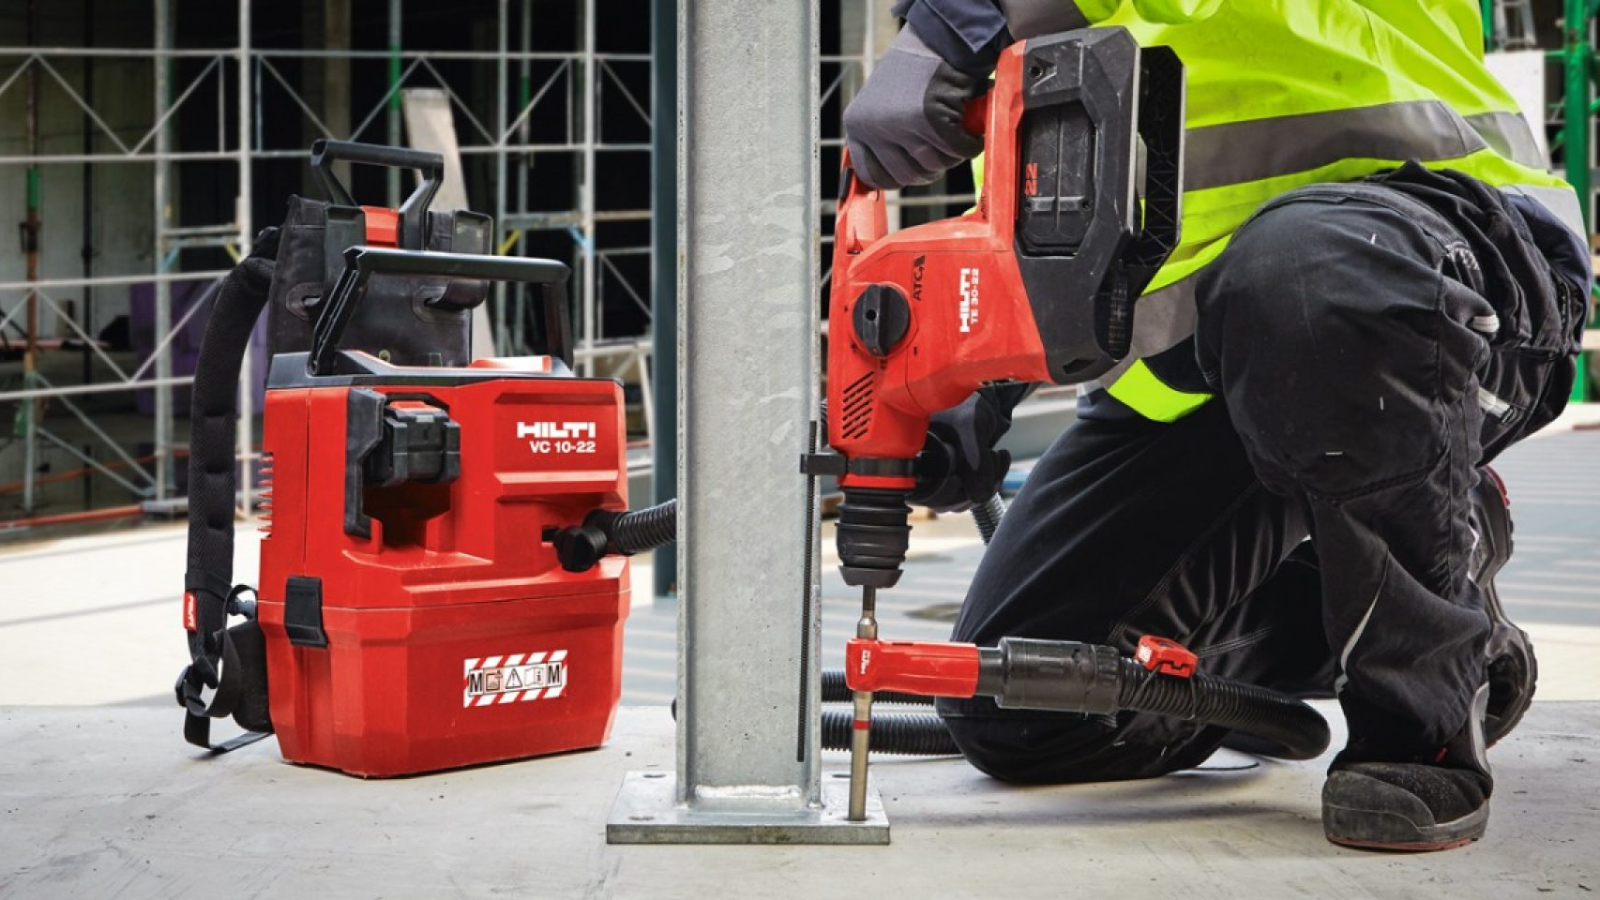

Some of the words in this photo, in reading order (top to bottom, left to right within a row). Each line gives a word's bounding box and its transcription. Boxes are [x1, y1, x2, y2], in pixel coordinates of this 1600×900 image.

[1025, 163, 1038, 195] 22
[960, 268, 970, 332] HILTI
[971, 268, 979, 306] 30-22
[971, 309, 979, 324] TE
[516, 421, 596, 438] HILTI
[529, 440, 551, 453] VC
[554, 440, 596, 454] 10-22
[469, 673, 482, 692] M
[548, 664, 560, 683] M
